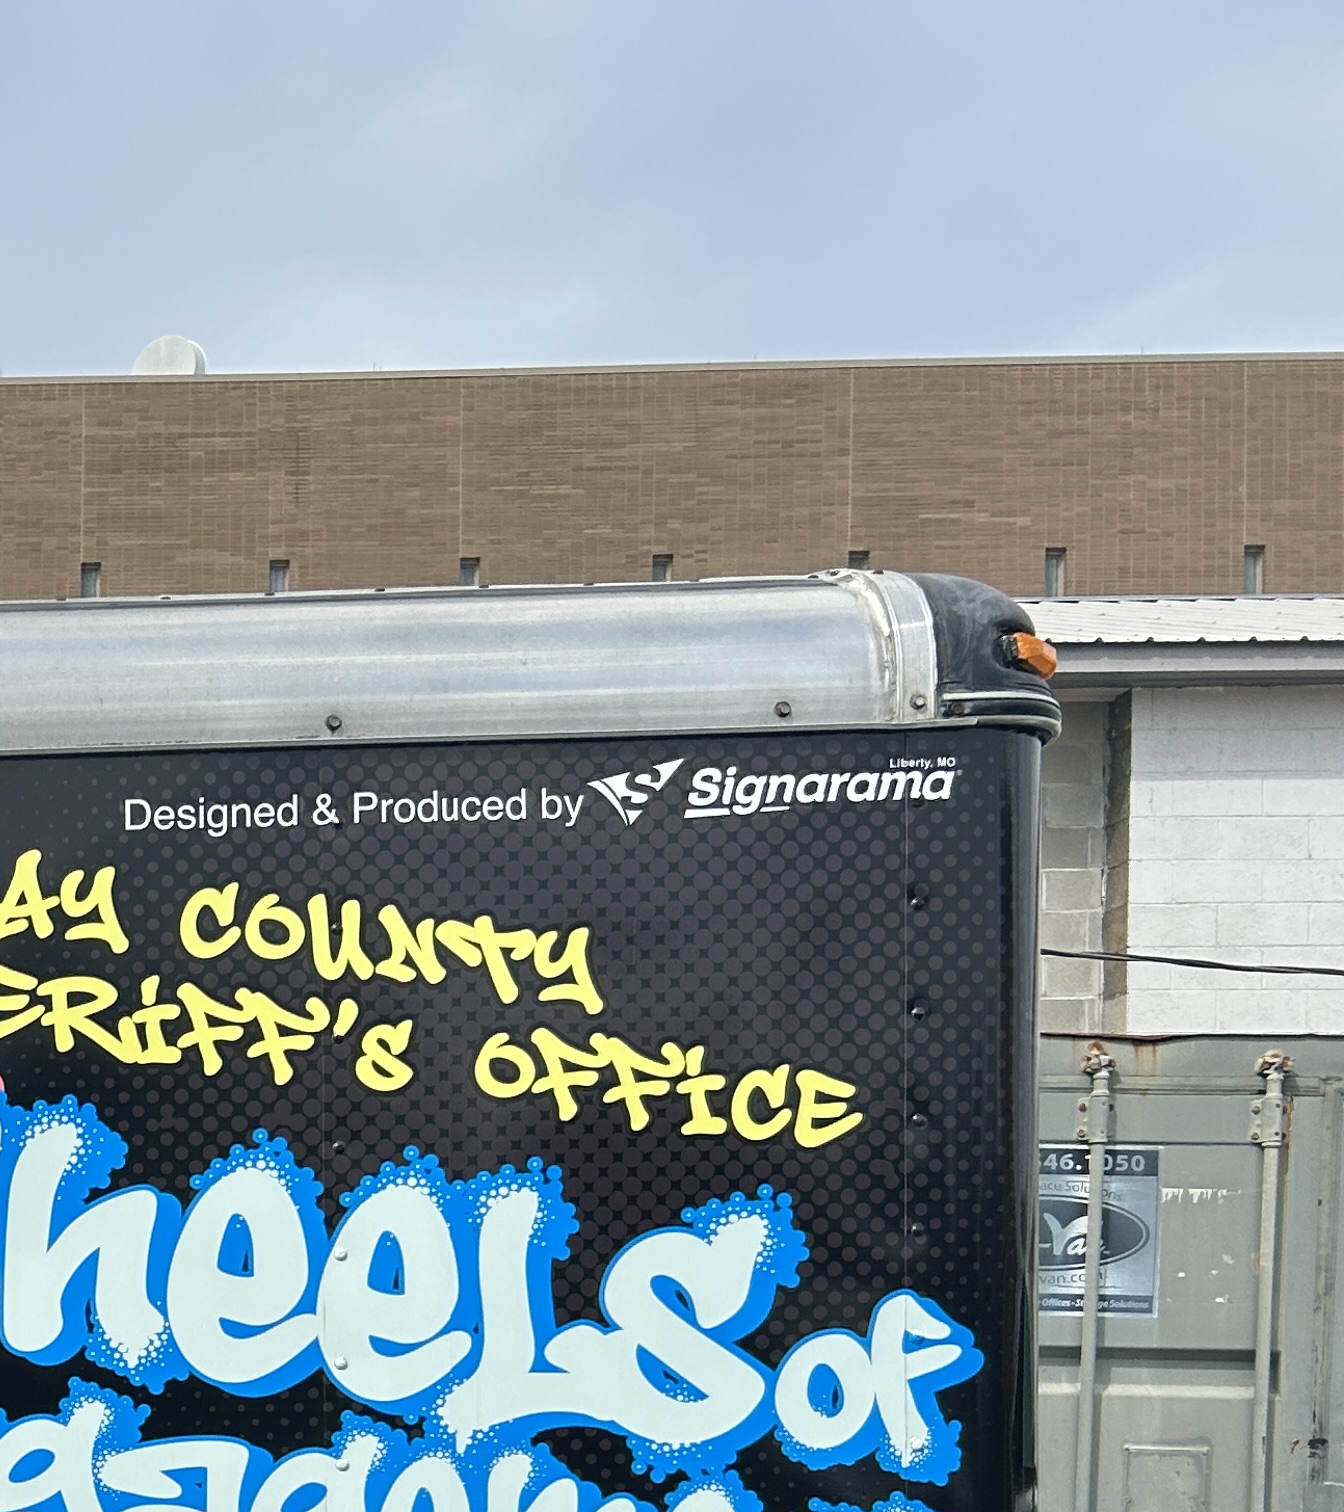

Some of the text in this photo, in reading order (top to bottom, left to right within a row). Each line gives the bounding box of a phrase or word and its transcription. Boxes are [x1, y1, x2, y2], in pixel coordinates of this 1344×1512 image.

[124, 765, 957, 839] Designed & Produced by Signarama
[937, 757, 957, 769] MO
[178, 881, 604, 1014] COUNTY
[774, 1294, 962, 1470] of
